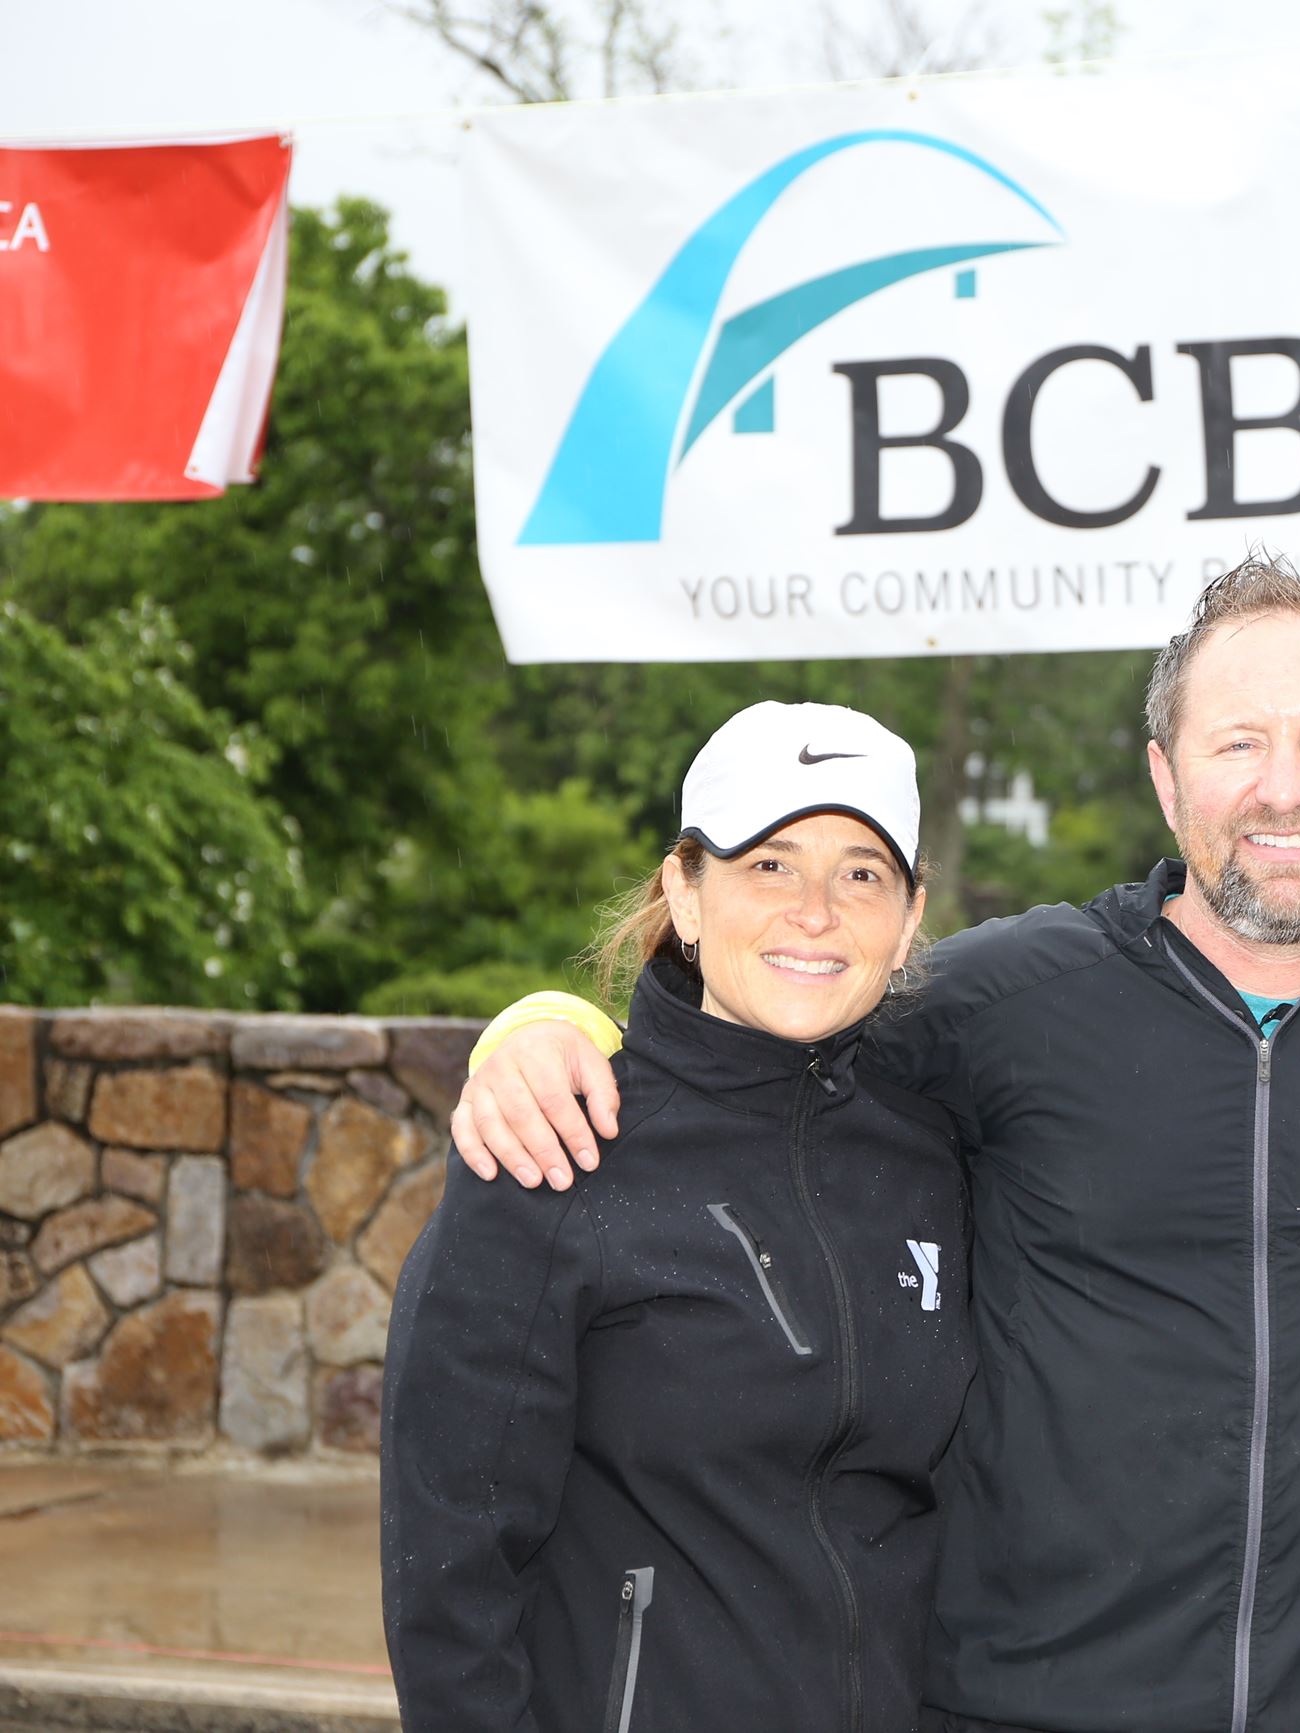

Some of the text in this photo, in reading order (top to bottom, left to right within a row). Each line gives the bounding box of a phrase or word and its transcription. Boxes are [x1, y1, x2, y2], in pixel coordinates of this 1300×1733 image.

[680, 572, 815, 622] YOUR
[840, 560, 1175, 617] COMMUNITY
[897, 1271, 919, 1288] the
